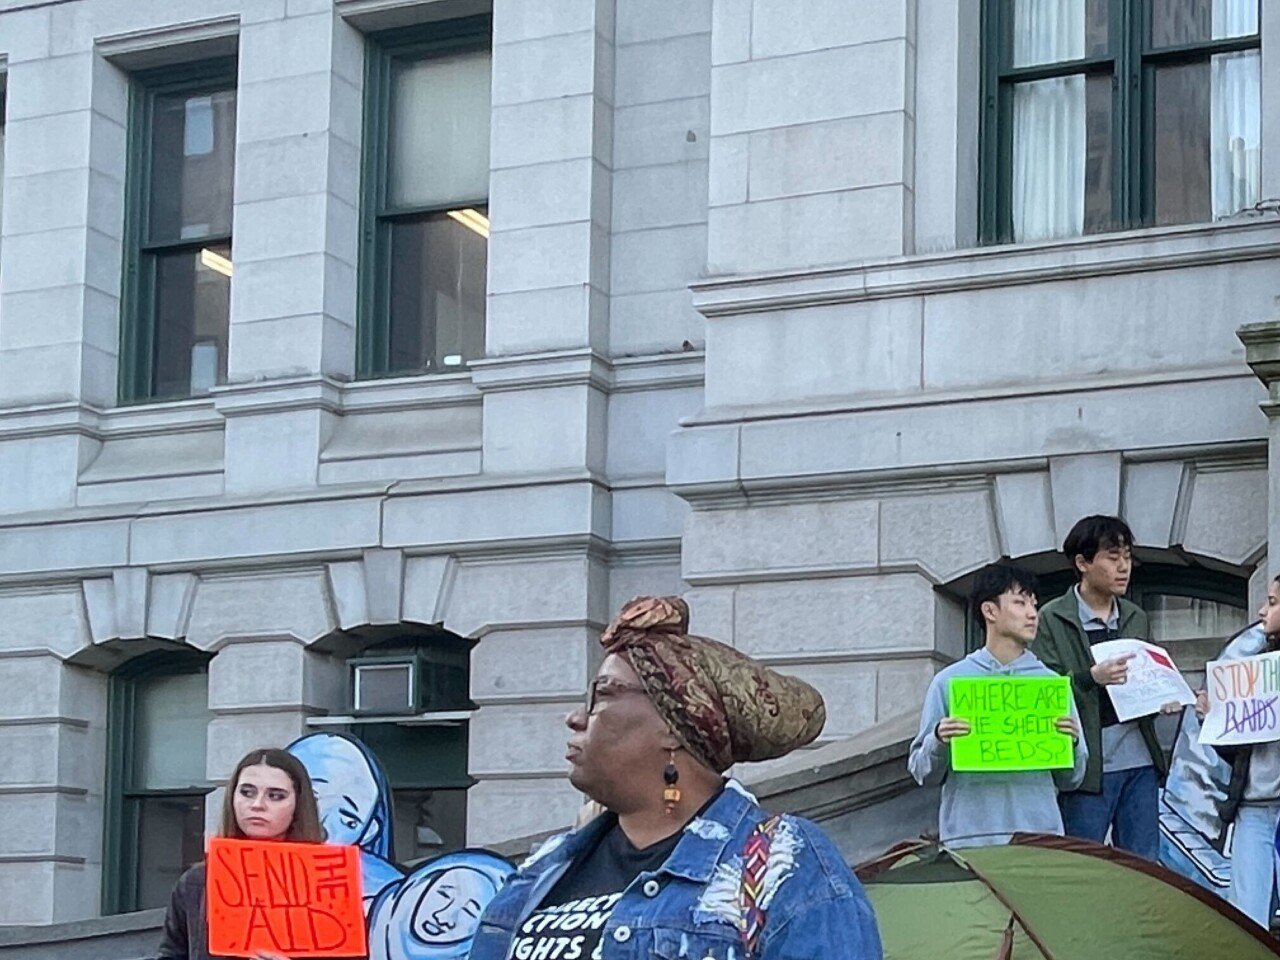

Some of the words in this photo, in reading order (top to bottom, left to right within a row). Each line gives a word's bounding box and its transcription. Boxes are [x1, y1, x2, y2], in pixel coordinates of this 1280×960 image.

[952, 682, 1028, 712] WHERE
[1034, 685, 1067, 710] ARE
[1212, 662, 1259, 701] STOP
[1001, 713, 1057, 736] SHELT
[1221, 697, 1278, 736] RAIDS
[980, 737, 1067, 763] BEDS?
[215, 847, 310, 908] SEND
[312, 847, 349, 903] THE
[243, 898, 347, 952] AID
[522, 911, 612, 933] CTION
